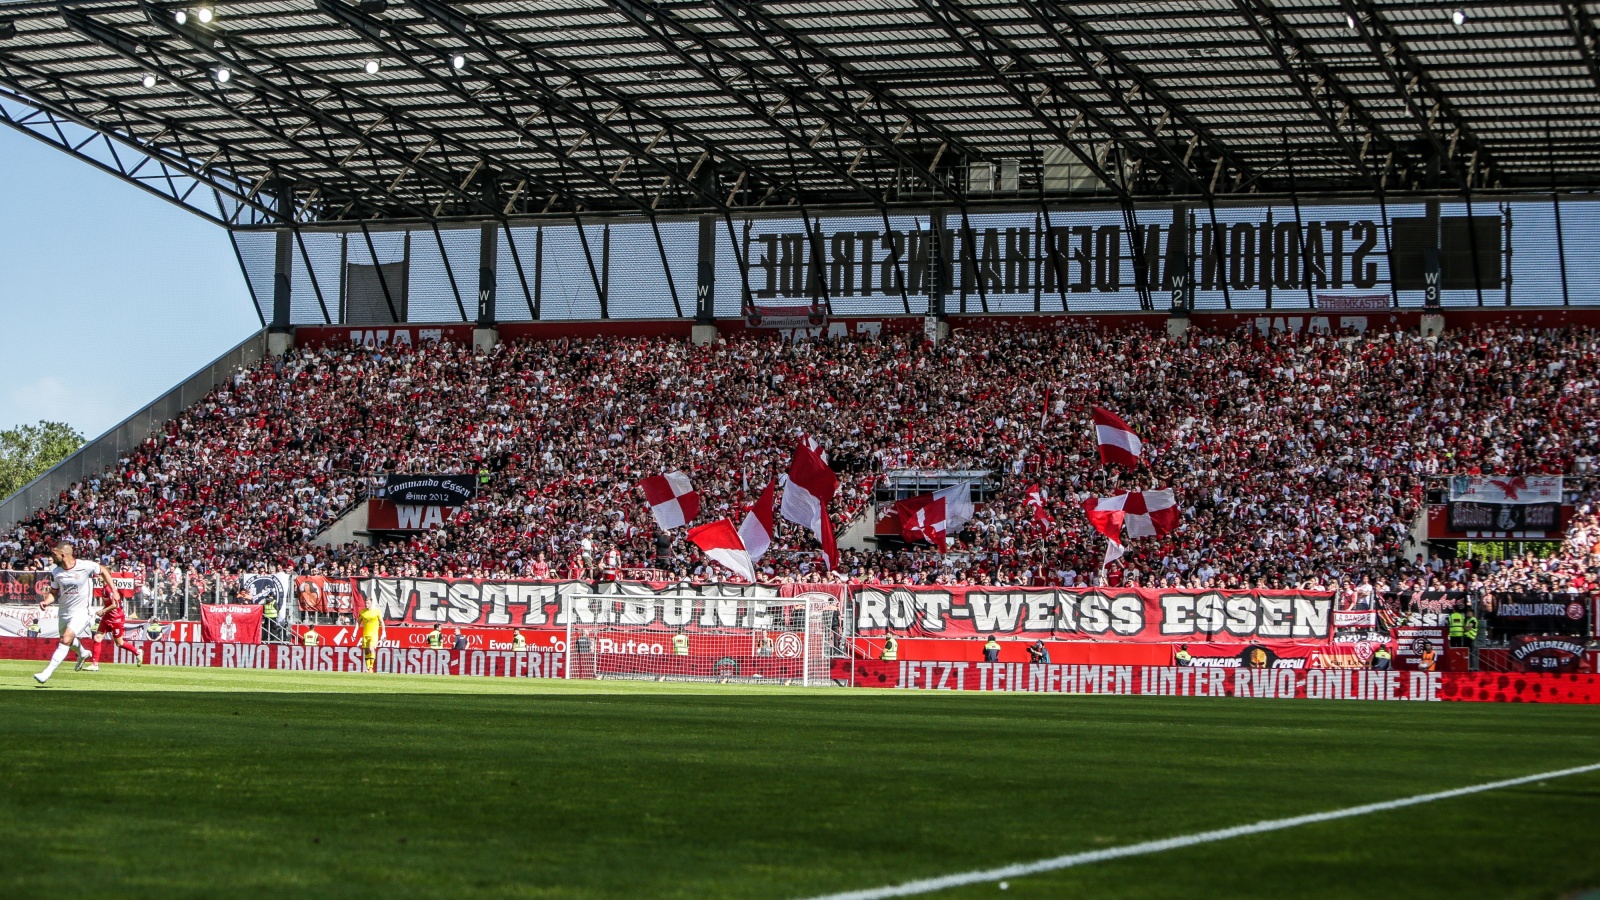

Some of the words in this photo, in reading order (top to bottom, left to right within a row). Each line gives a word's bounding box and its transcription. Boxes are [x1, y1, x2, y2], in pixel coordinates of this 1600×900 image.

[1171, 275, 1185, 288] W
[1425, 272, 1438, 285] W
[479, 289, 490, 301] W
[697, 285, 709, 297] W
[1173, 289, 1183, 304] 2
[1426, 286, 1436, 300] 3
[480, 302, 486, 316] 1
[699, 298, 705, 311] 1
[387, 478, 439, 495] Commando
[441, 479, 471, 498] Essen
[405, 491, 428, 500] Since
[429, 493, 449, 502] 2012
[326, 594, 352, 609] ESS
[854, 589, 1144, 635] ROT-WEISS
[1160, 591, 1332, 637] ESSEN
[1497, 601, 1543, 617] ADRENALIN
[1543, 603, 1566, 616] BOYS
[598, 638, 664, 655] Buteo
[113, 641, 144, 665] DIE
[222, 643, 270, 669] RWO
[277, 644, 563, 679] BRUSTSONSOR-LOTTERIE
[1541, 657, 1558, 668] 97A
[895, 660, 970, 690] JETZT
[976, 662, 1133, 695] TEILNEHMEN
[1140, 665, 1225, 697] UNTER
[1234, 668, 1443, 702] RWO-ONLINE.DE
